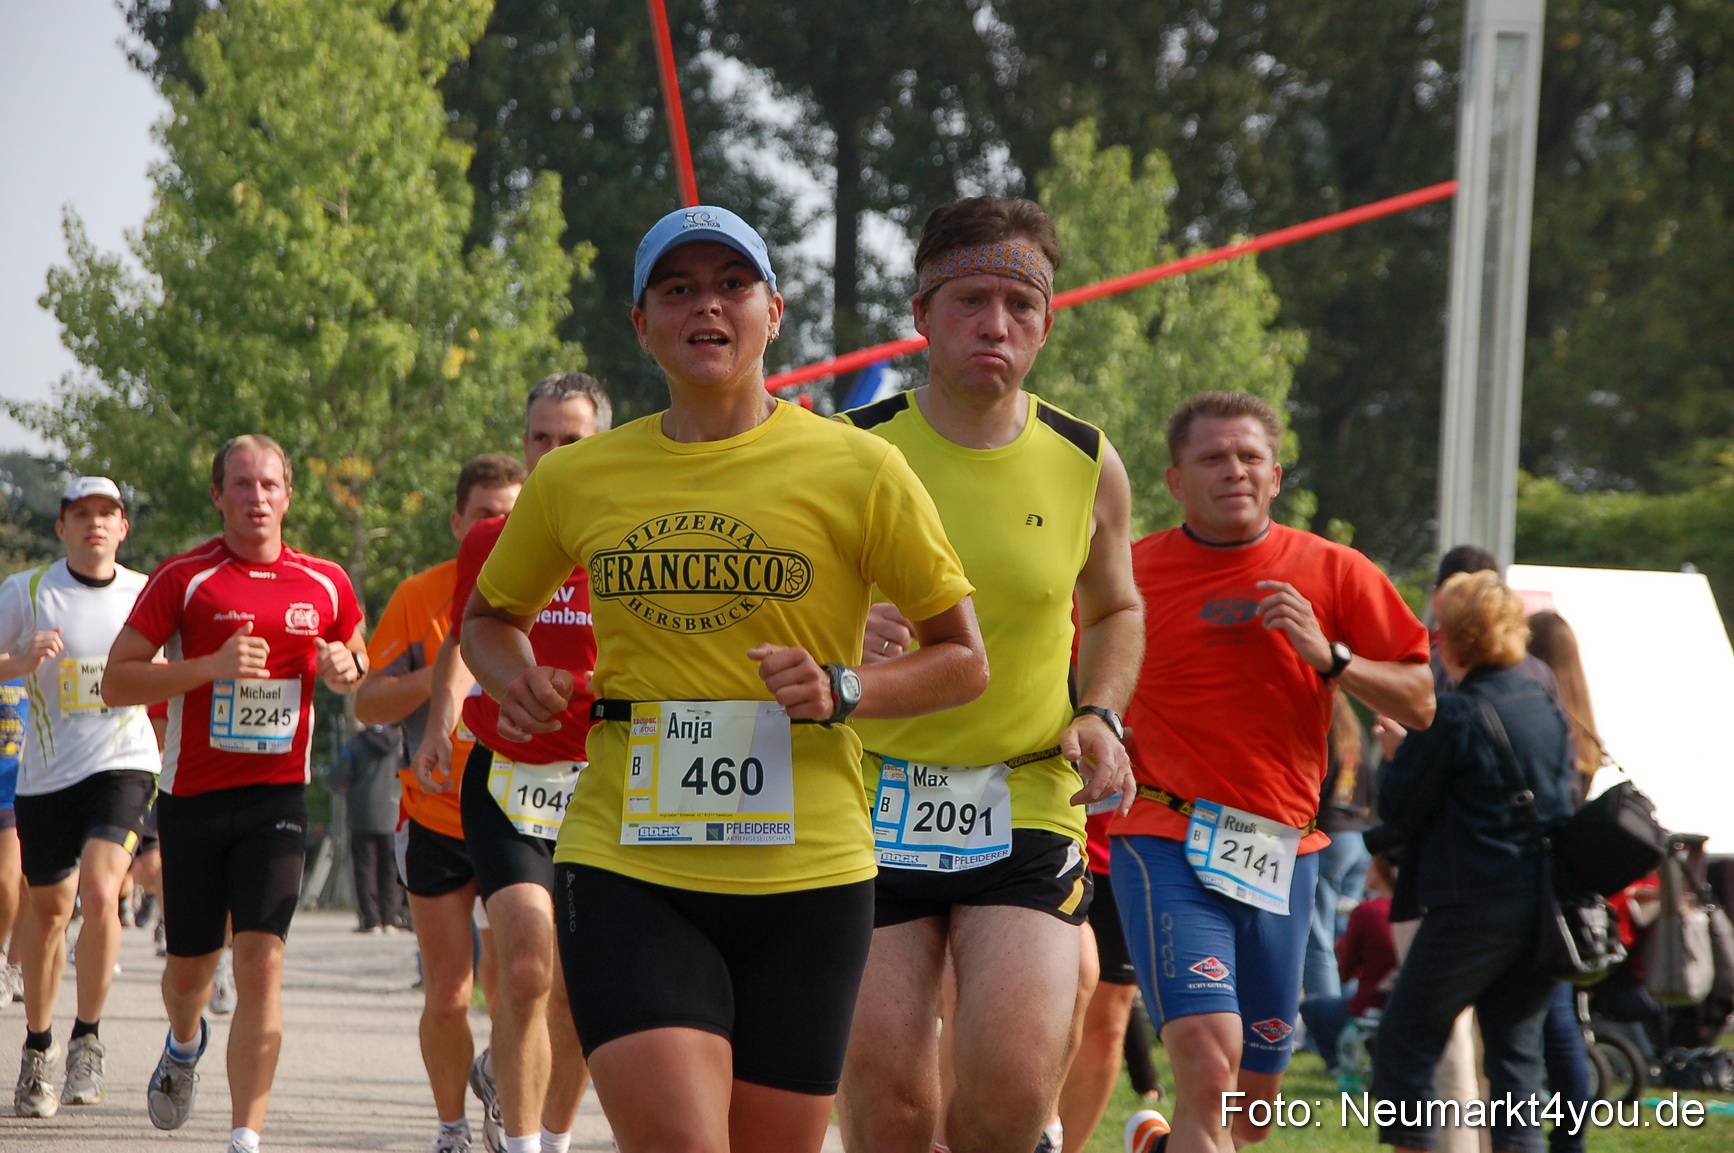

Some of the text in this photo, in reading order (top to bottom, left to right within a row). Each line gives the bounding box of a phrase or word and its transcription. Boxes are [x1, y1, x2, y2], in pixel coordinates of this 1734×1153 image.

[625, 515, 756, 550] PIZZERIA
[603, 553, 784, 593] FRANCESCO
[628, 597, 757, 631] HERSBRUCK
[240, 684, 281, 700] Michael
[218, 704, 224, 715] A
[239, 707, 291, 727] 2245
[666, 712, 712, 744] Anja
[632, 756, 641, 776] B
[681, 757, 764, 795] 460
[913, 765, 949, 787] Max
[880, 797, 891, 812] B
[726, 823, 790, 834] PFLEIDERER
[912, 801, 992, 836] 2091
[638, 826, 681, 837] BOCK
[1193, 830, 1201, 841] B
[880, 852, 920, 863] BOCK
[954, 850, 1008, 865] PFLEIDERER
[1220, 839, 1281, 883] 2141
